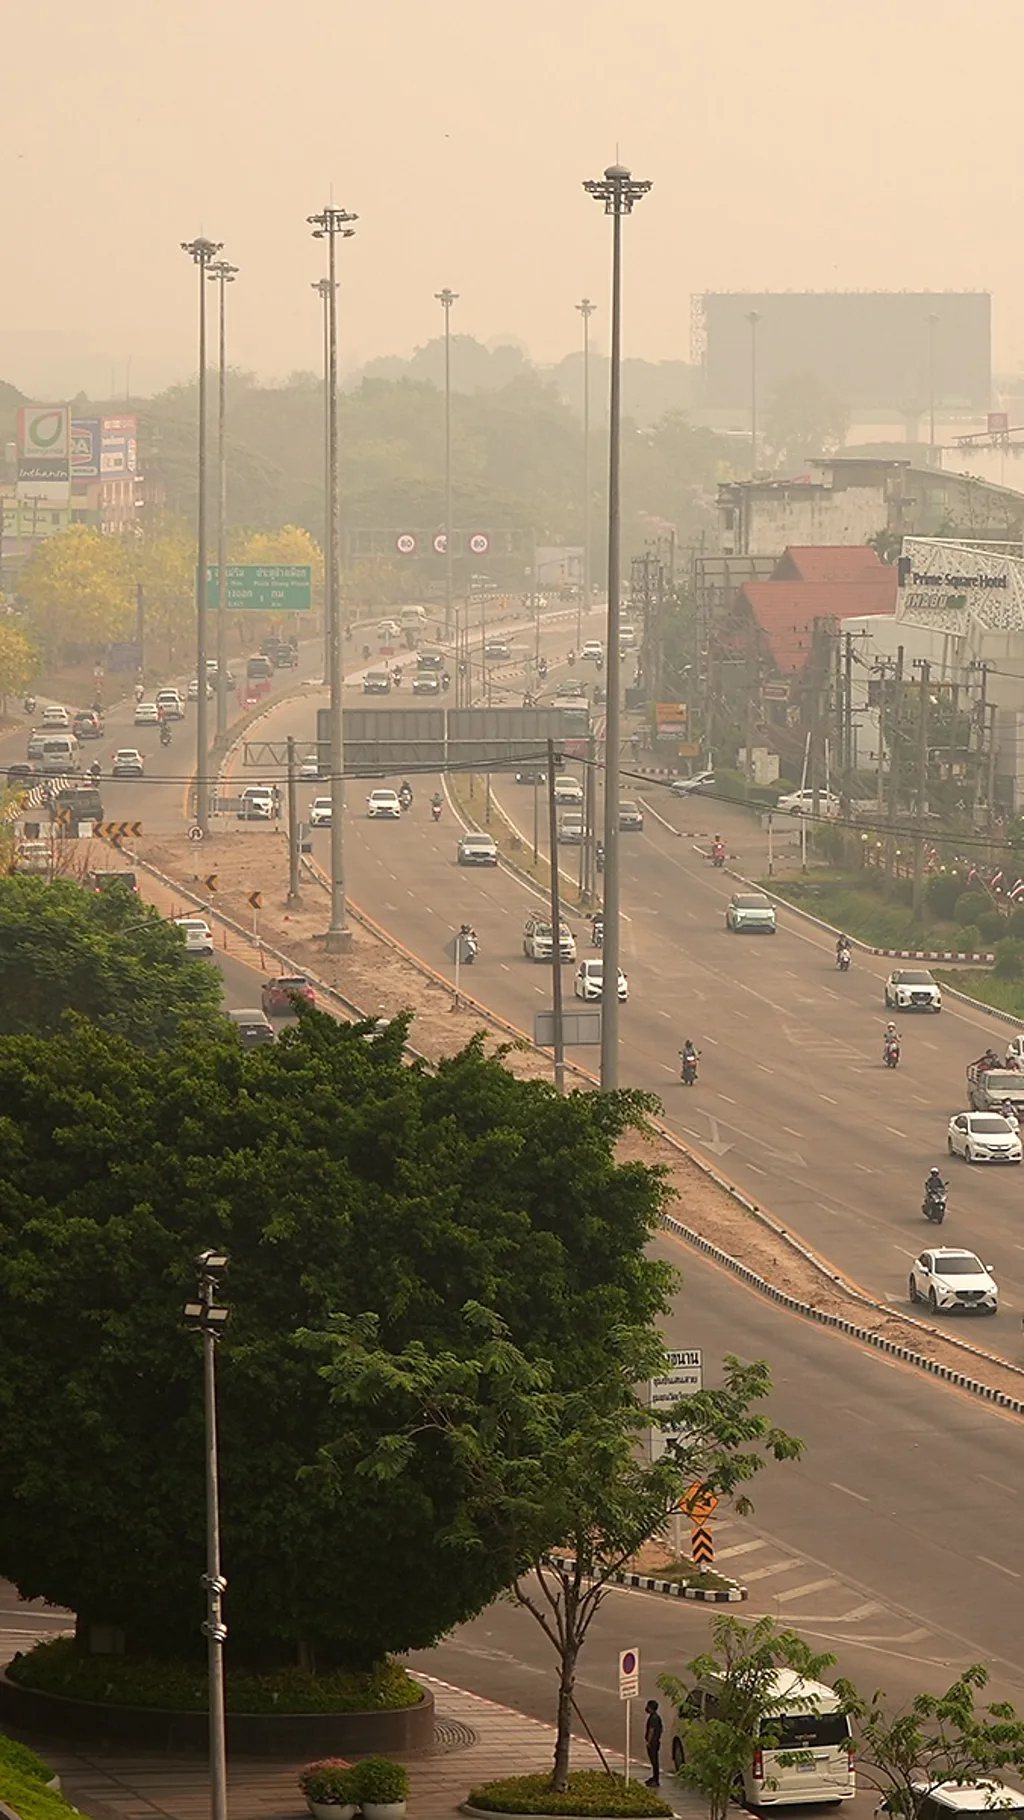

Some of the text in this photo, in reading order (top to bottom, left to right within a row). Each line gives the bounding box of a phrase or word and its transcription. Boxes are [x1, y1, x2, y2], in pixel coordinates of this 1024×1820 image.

[912, 572, 1007, 590] Prime Square Hotel
